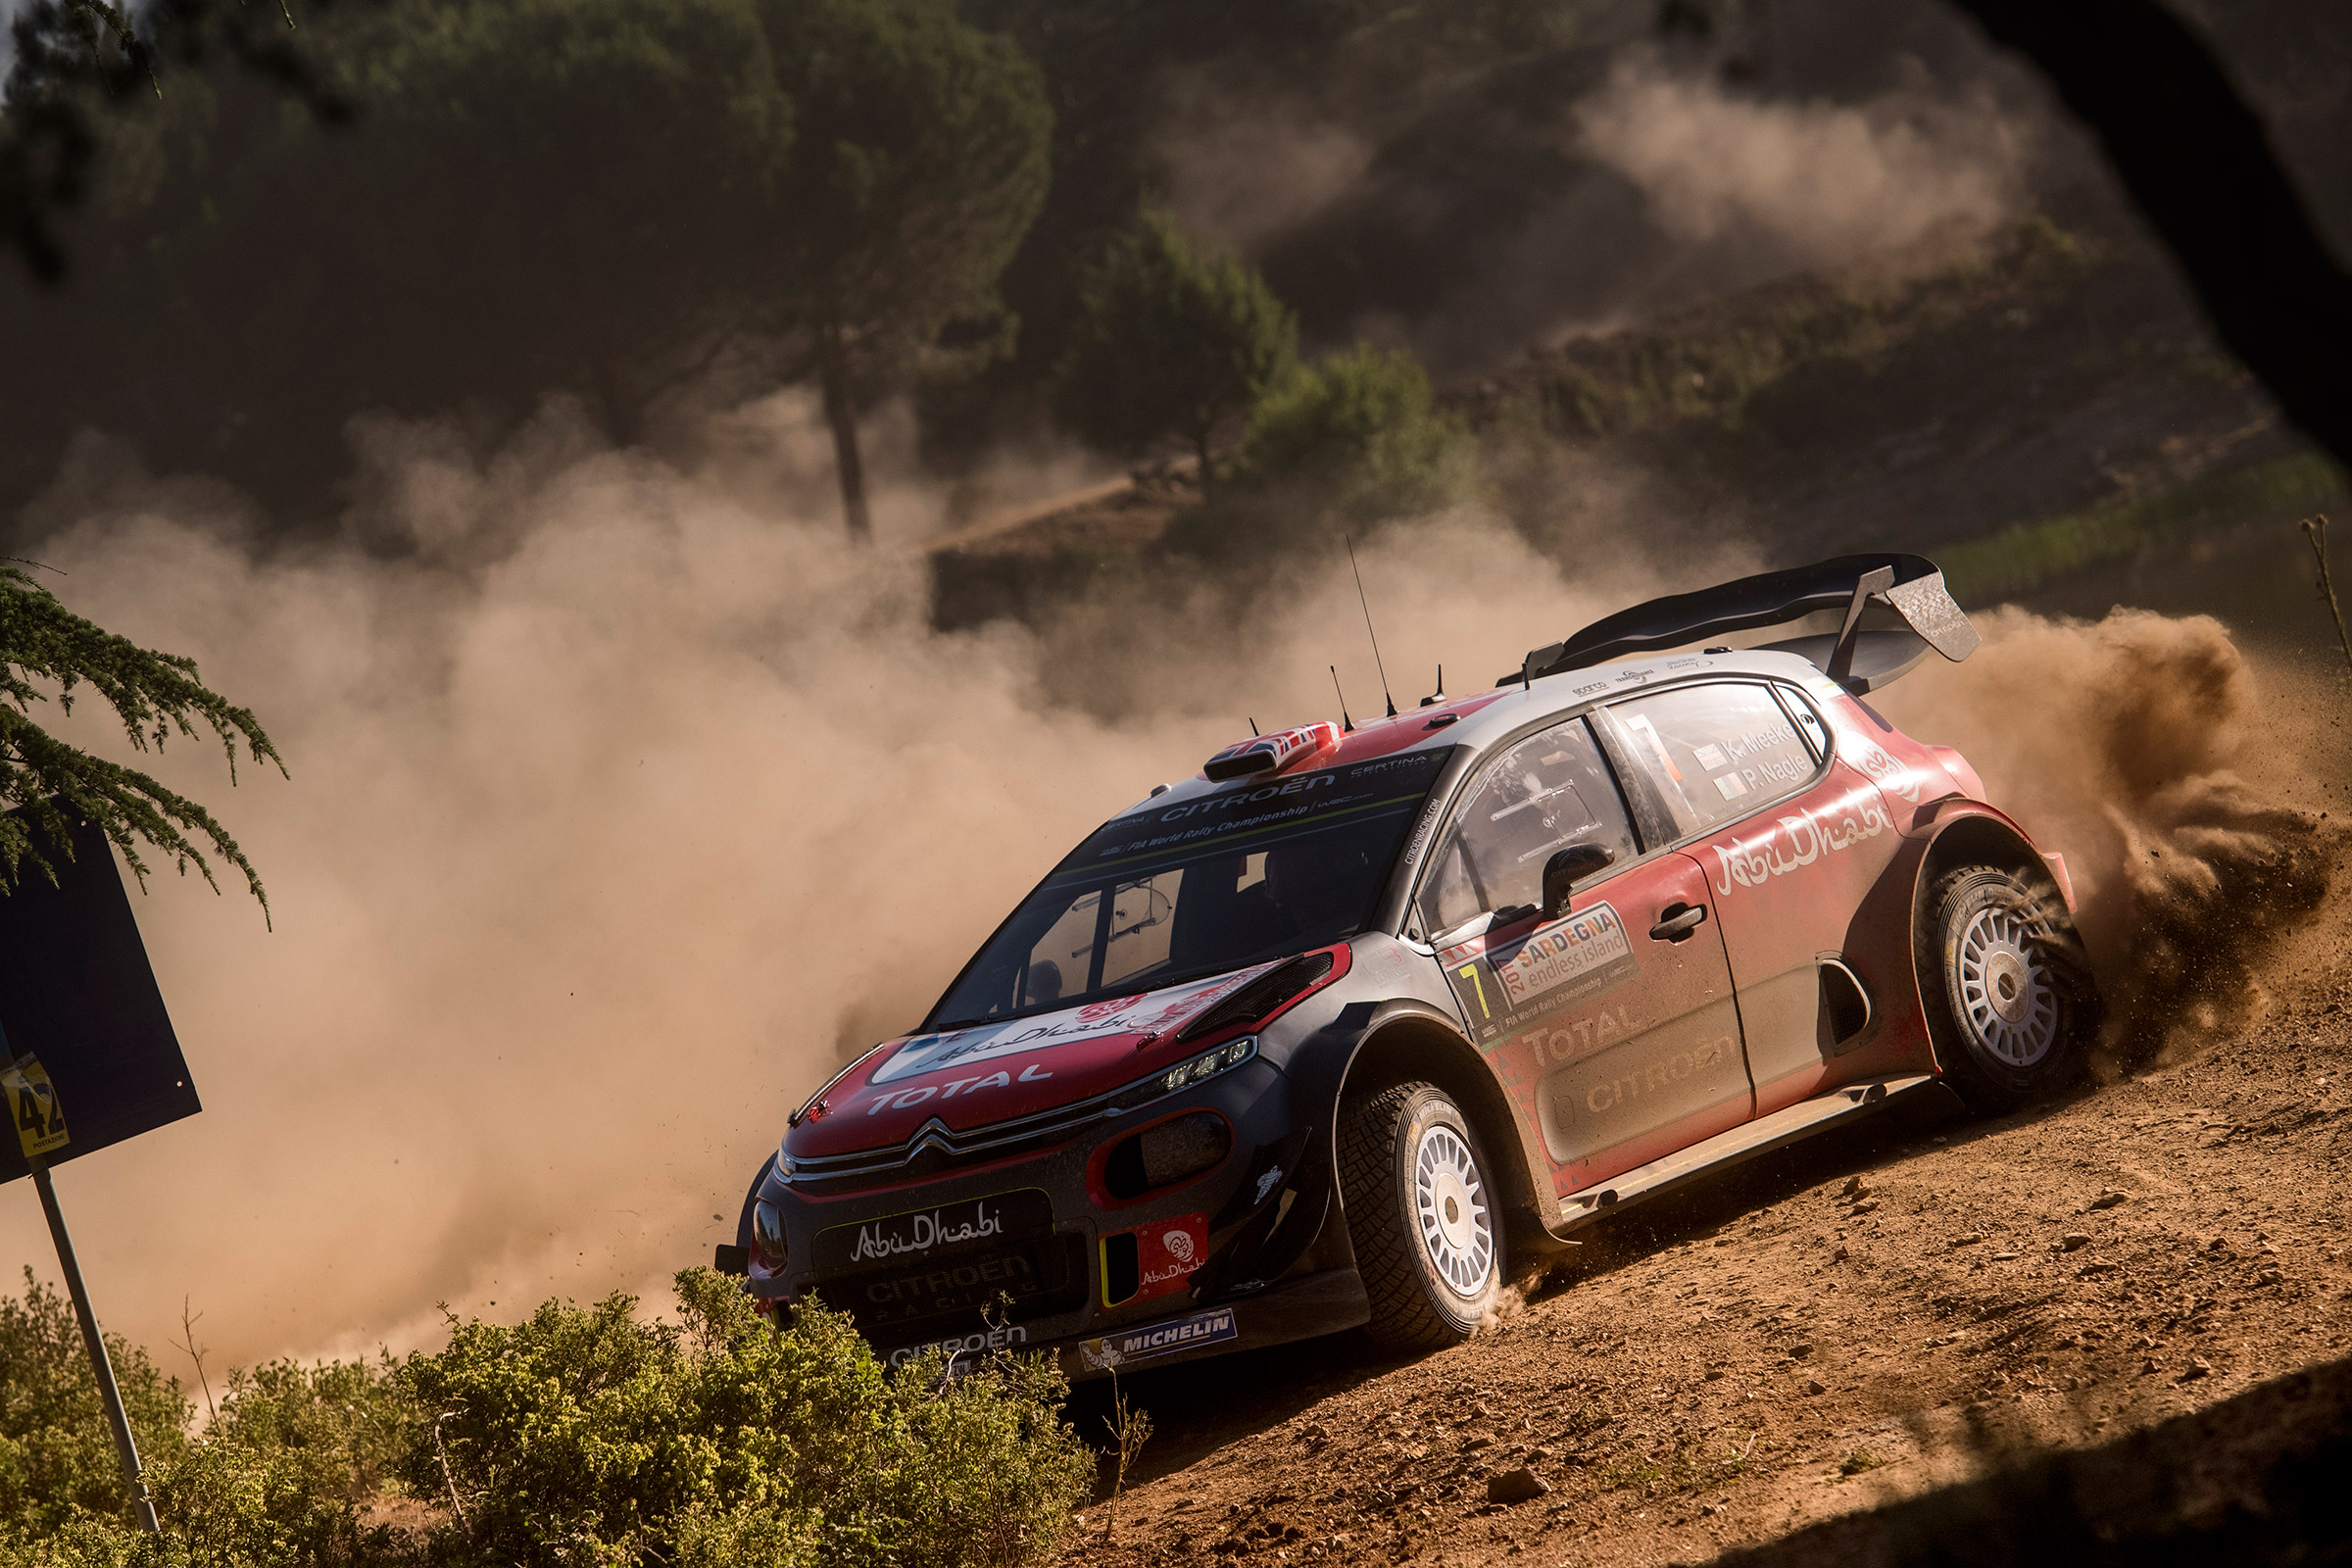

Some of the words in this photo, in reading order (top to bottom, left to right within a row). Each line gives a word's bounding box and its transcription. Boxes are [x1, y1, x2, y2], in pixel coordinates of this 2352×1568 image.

[1350, 754, 1427, 776] CERTINA
[1742, 722, 1794, 758] Meeke
[1740, 768, 1764, 791] P.
[1757, 753, 1809, 782] Nagle
[1160, 774, 1337, 823] CITROËN
[1128, 839, 1149, 851] FIA
[1149, 831, 1184, 847] World
[1184, 826, 1215, 840] Rally
[1217, 805, 1308, 833] Championship
[1404, 798, 1441, 865] CITROENRACING.COM
[1515, 912, 1617, 968] SARDEGNA
[1528, 954, 1582, 988] endless
[1580, 931, 1624, 964] island
[1458, 963, 1491, 1019] 7
[1494, 957, 1526, 996] 2017
[1504, 1016, 1519, 1029] FIA
[1518, 1004, 1539, 1021] World
[1539, 997, 1556, 1011] Rally
[1556, 977, 1602, 1004] Championship
[1521, 1005, 1641, 1068] TOTAL
[19, 1083, 65, 1139] 42
[866, 1064, 1054, 1116] TOTAL
[32, 1133, 66, 1151] POSTAZIONE
[1123, 1314, 1231, 1353] MICHELIN
